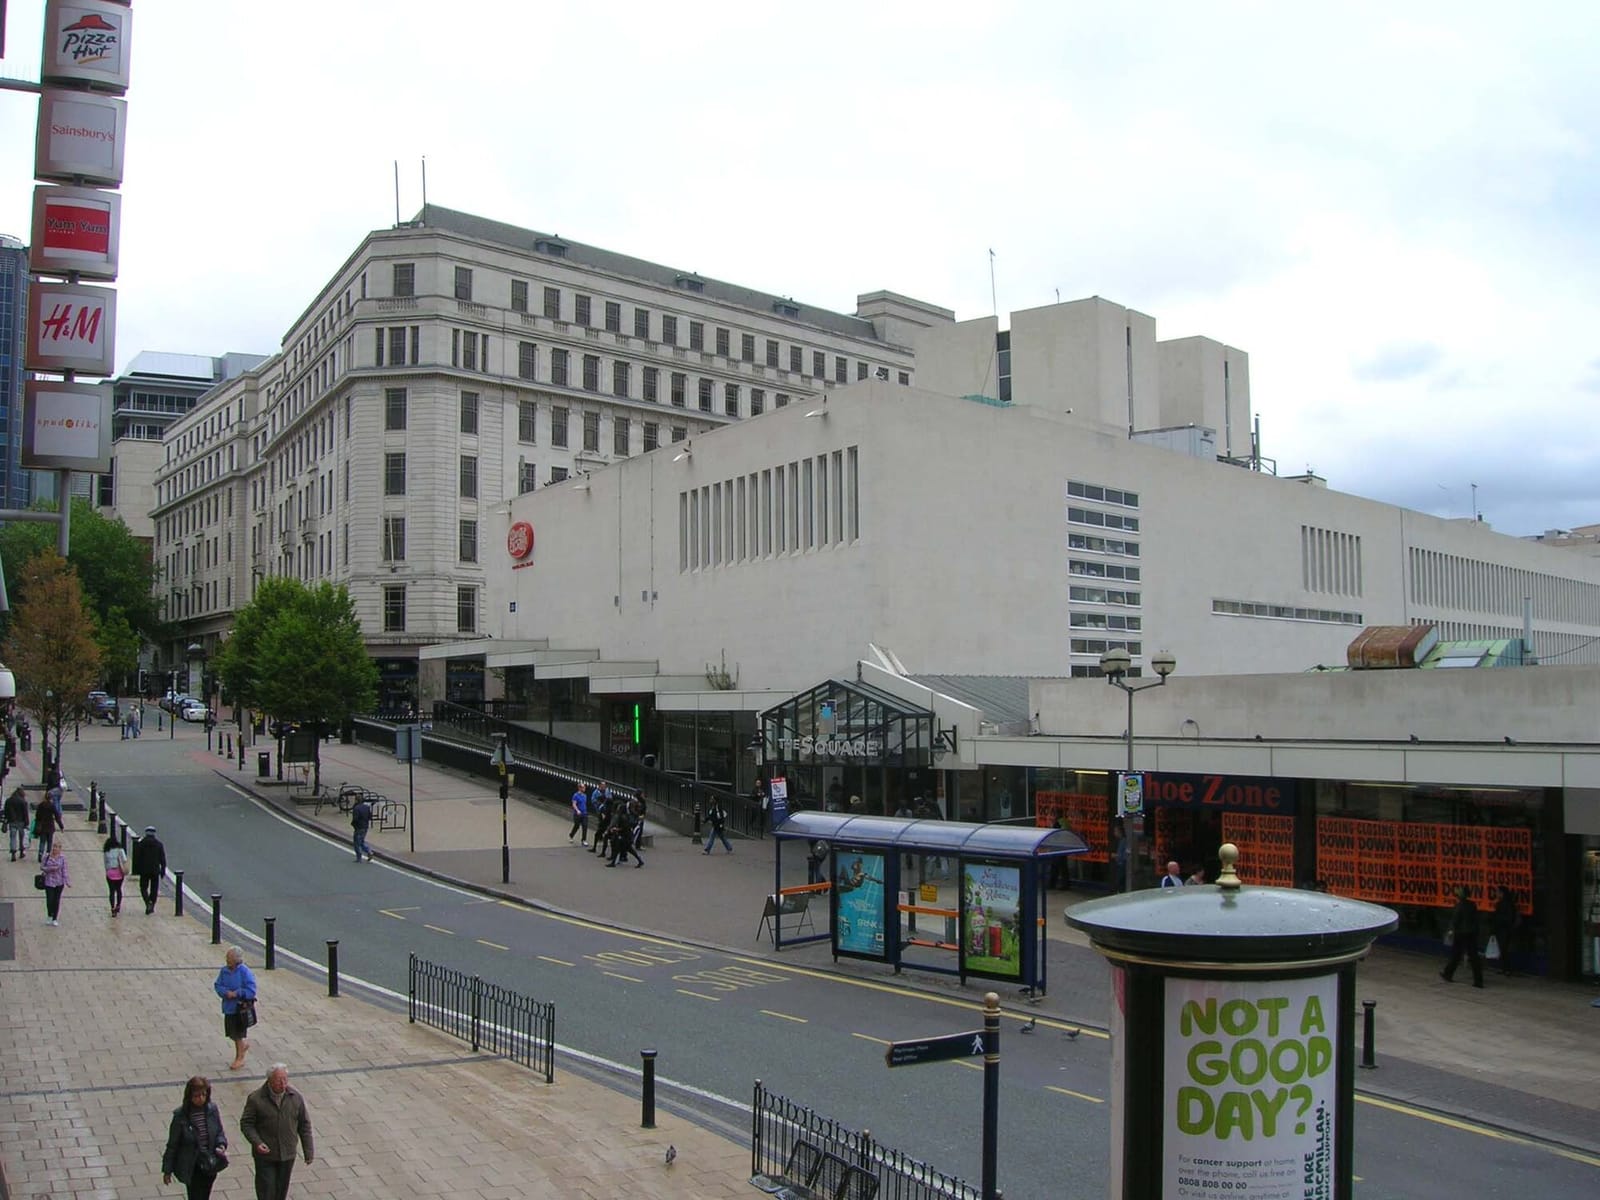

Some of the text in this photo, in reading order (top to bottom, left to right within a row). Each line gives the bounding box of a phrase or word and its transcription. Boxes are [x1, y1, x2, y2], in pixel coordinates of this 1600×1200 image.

[62, 29, 117, 53] Pizza
[72, 44, 112, 60] Hut
[52, 124, 115, 142] Sainsbury's
[42, 303, 102, 344] H&M
[778, 738, 800, 750] THE
[1143, 772, 1194, 802] hoe
[1202, 774, 1281, 808] Zone
[1223, 814, 1292, 831] CLOSING CLOSING
[1224, 828, 1292, 844] DOWN DOWN
[1319, 821, 1528, 845] CLOSING CLOSING CLOSING CLOSING CLOSING
[1320, 833, 1354, 849] DOWN
[1358, 837, 1394, 852] DOWN
[1399, 839, 1437, 855] DOWN
[1441, 842, 1482, 858] DOWN
[1487, 845, 1528, 861] DOWN
[1259, 854, 1291, 867] CLOSING
[1259, 867, 1292, 880] DOWN
[1319, 860, 1530, 886] CLOSING CLOSING CLOSING CLOSING CLOSING
[1359, 878, 1396, 892] DOWN
[1400, 879, 1437, 894] DOWN
[1180, 995, 1325, 1037] NOT A
[1187, 1036, 1332, 1087] GOOD
[1177, 1084, 1313, 1141] DAY?
[1315, 1099, 1325, 1200] ACMILLAN.
[1178, 1153, 1191, 1163] For
[1192, 1158, 1224, 1167] cancer
[1226, 1159, 1262, 1168] support
[1304, 1152, 1314, 1184] ARE
[1178, 1167, 1195, 1175] over
[1197, 1167, 1210, 1176] the
[1242, 1168, 1257, 1178] call
[1259, 1170, 1269, 1178] us
[1270, 1168, 1285, 1177] free
[1286, 1168, 1296, 1176] on
[1178, 1176, 1200, 1187] 0808
[1202, 1179, 1220, 1189] 808
[1221, 1181, 1233, 1190] 00
[1235, 1181, 1247, 1190] 00
[1178, 1187, 1189, 1196] Or
[1191, 1189, 1206, 1199] visit
[1208, 1191, 1217, 1200] us
